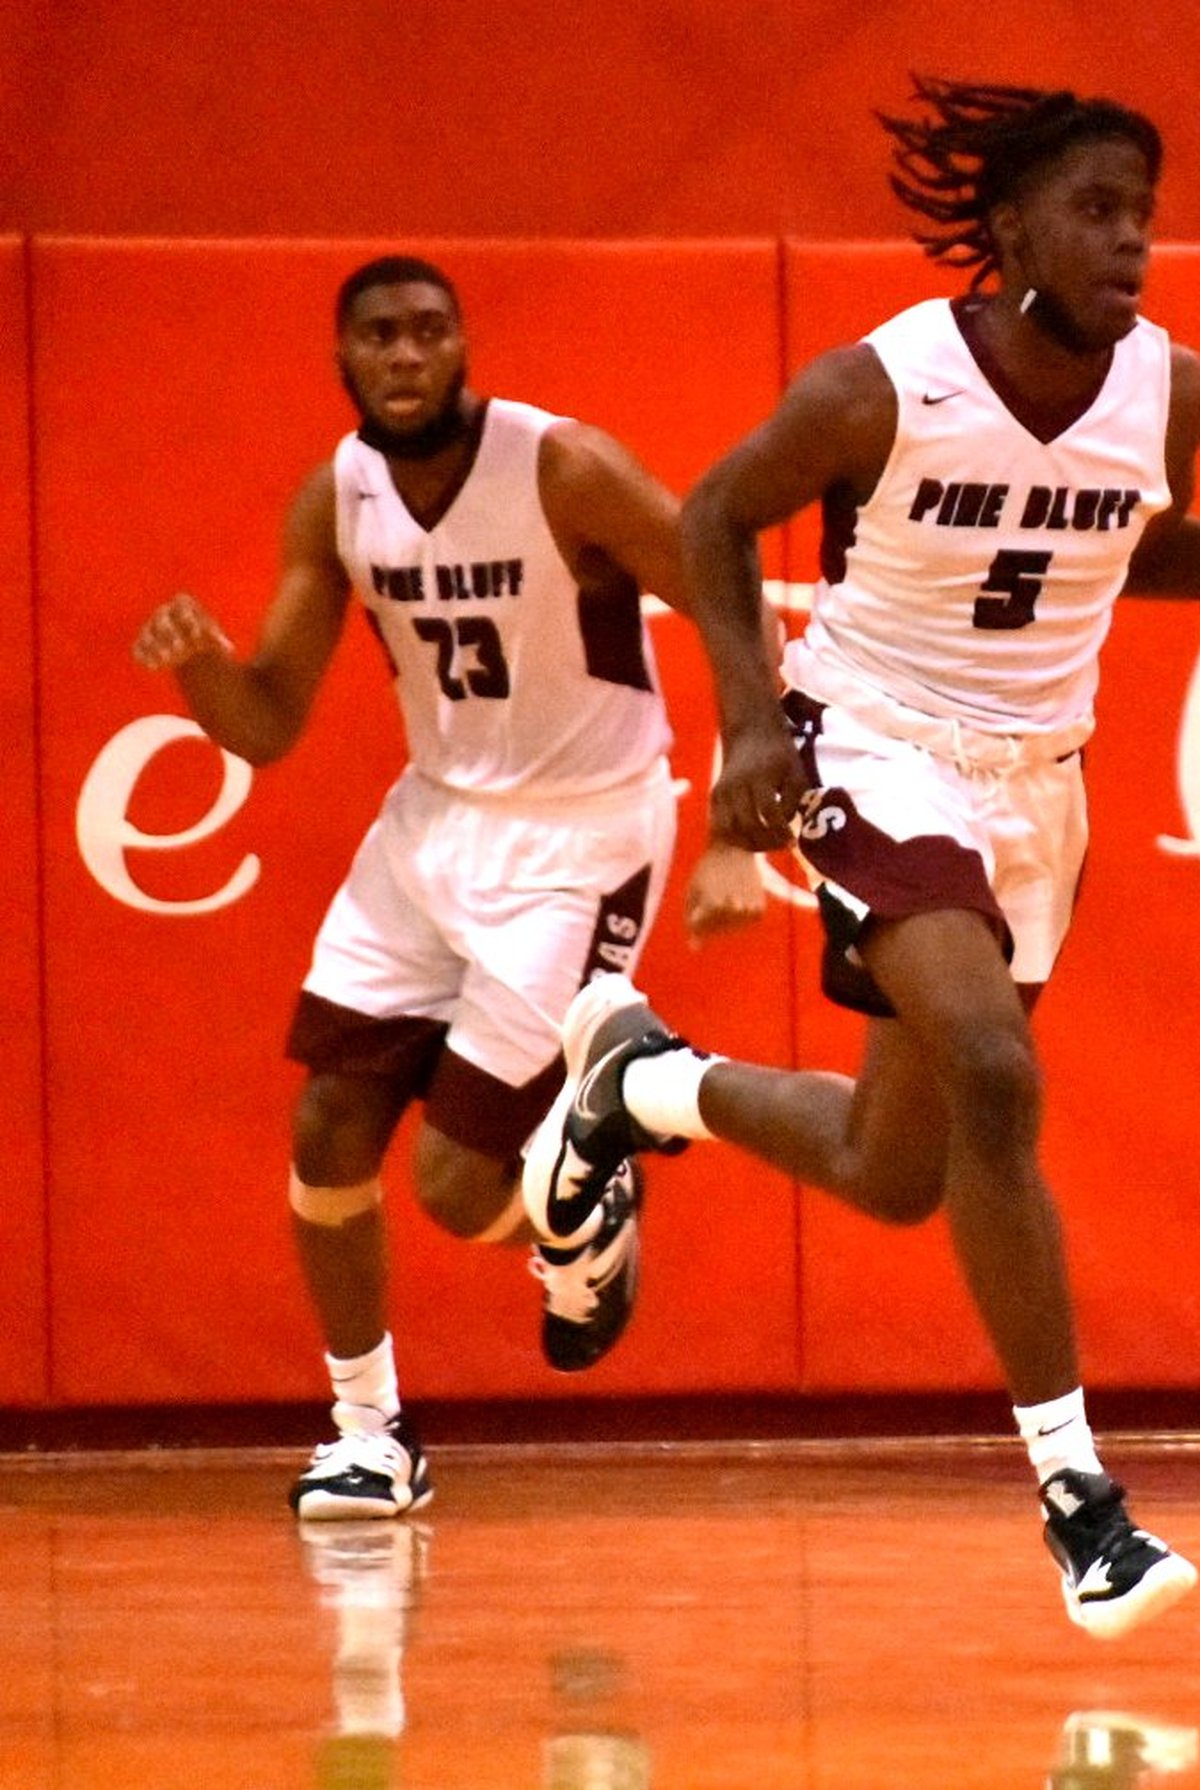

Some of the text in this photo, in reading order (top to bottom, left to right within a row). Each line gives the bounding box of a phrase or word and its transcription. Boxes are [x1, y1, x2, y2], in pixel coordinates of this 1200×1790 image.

[908, 477, 1143, 531] PINE BLUFF
[370, 557, 523, 601] PINE BLUFF
[971, 549, 1054, 630] 5
[411, 616, 511, 702] 23
